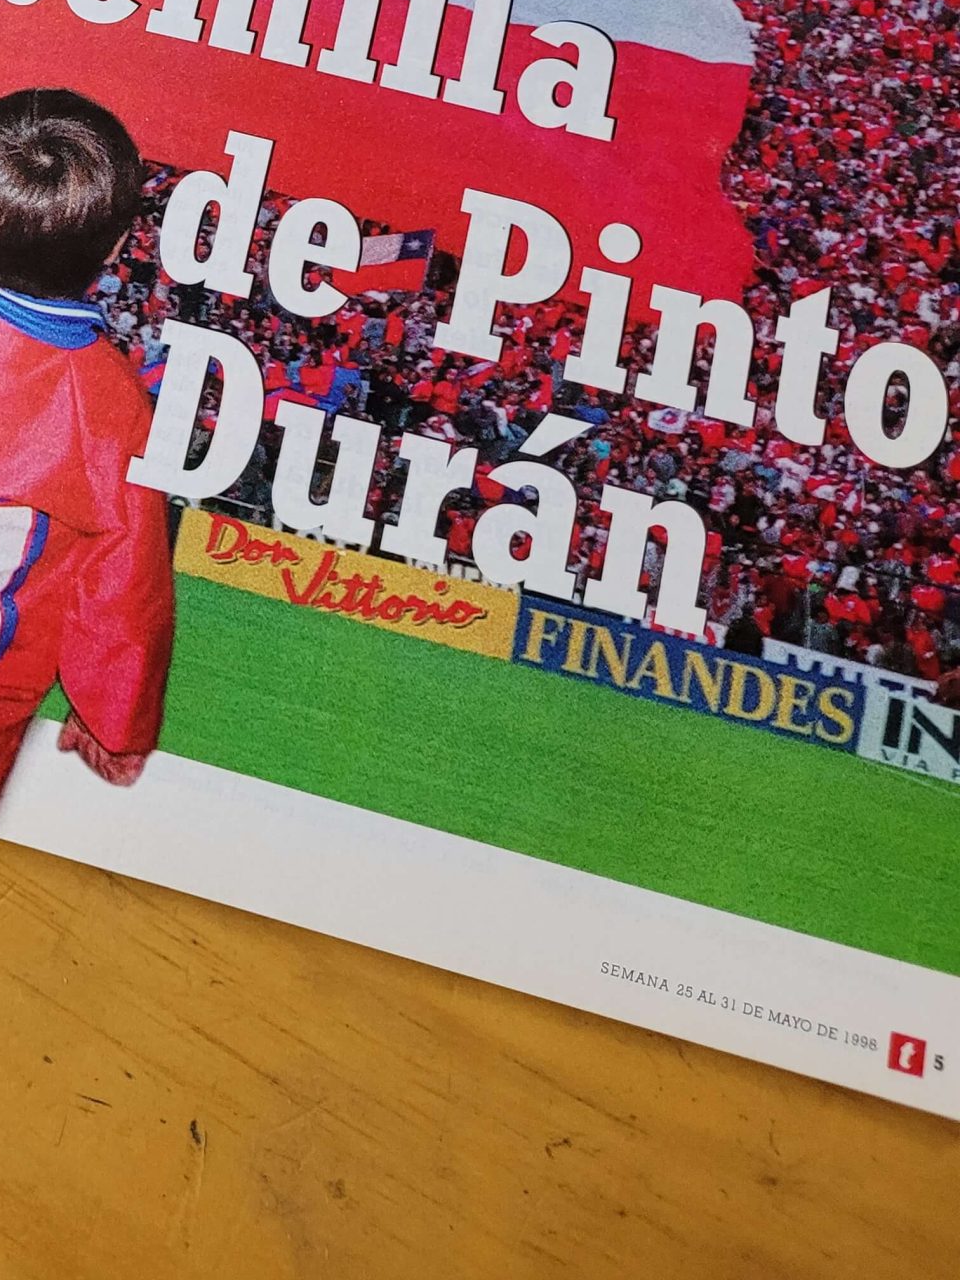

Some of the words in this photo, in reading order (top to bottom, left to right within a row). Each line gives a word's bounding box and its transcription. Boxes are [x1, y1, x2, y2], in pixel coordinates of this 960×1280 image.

[158, 130, 362, 318] de
[433, 188, 950, 470] Pinto
[124, 319, 709, 637] Durán
[206, 513, 300, 563] Don
[281, 551, 487, 628] Vittorio
[520, 608, 855, 744] FINANDES
[600, 961, 670, 992] SEMANA
[676, 983, 694, 999] 25
[697, 990, 717, 1006] AL
[720, 997, 737, 1012] 31
[743, 1002, 764, 1019] DE
[769, 1009, 813, 1033] MAYO
[817, 1023, 838, 1041] DE
[933, 1055, 945, 1072] 5
